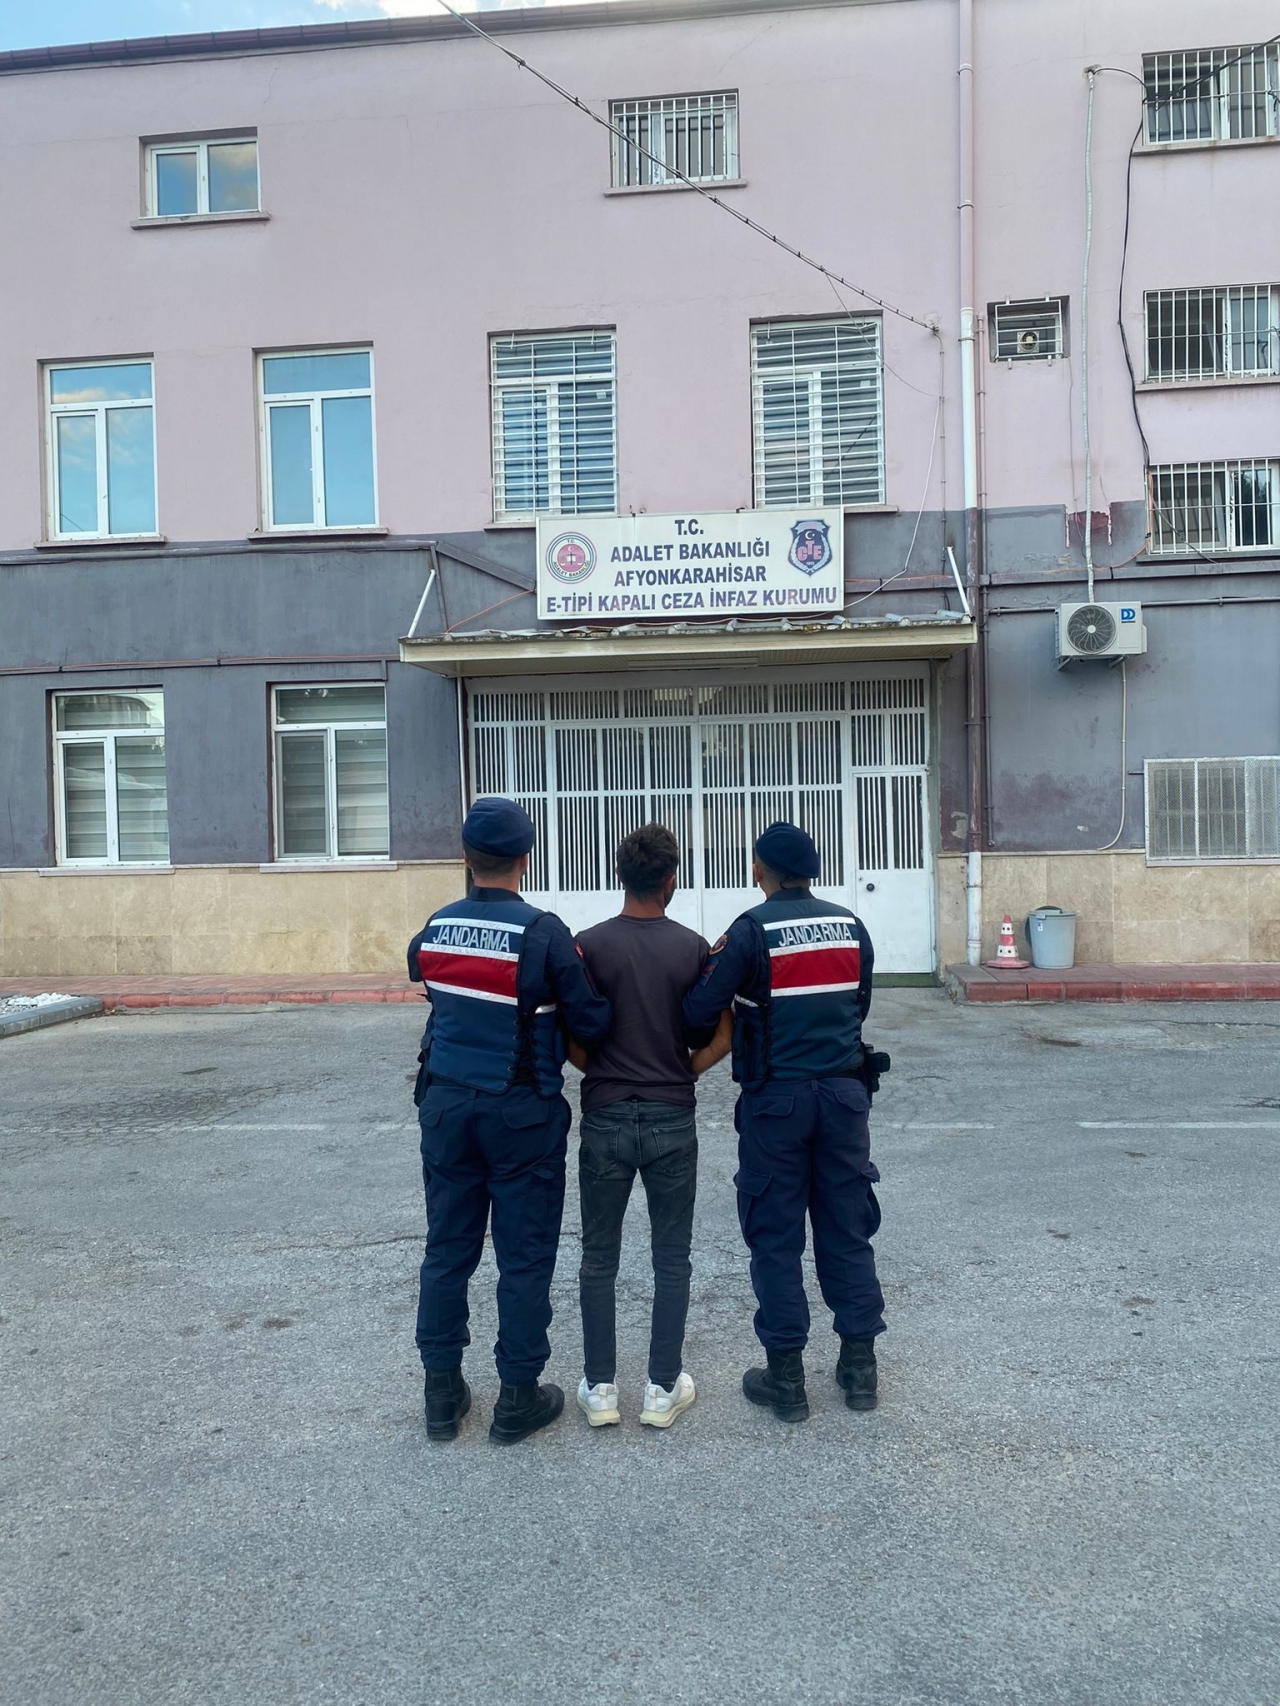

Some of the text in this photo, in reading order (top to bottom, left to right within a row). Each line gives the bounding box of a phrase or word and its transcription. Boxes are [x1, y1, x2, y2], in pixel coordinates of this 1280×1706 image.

[675, 519, 704, 536] T.C.
[611, 537, 770, 562] ADALET BAKANLIĞI
[797, 540, 822, 561] CTE
[614, 563, 767, 586] AFYONKARAHİSAR
[547, 587, 837, 612] E-TİPİ KAPALI CEZA İNFAZ KURUMU
[433, 925, 510, 952] JANDARMA
[779, 923, 852, 947] JANDARMA
